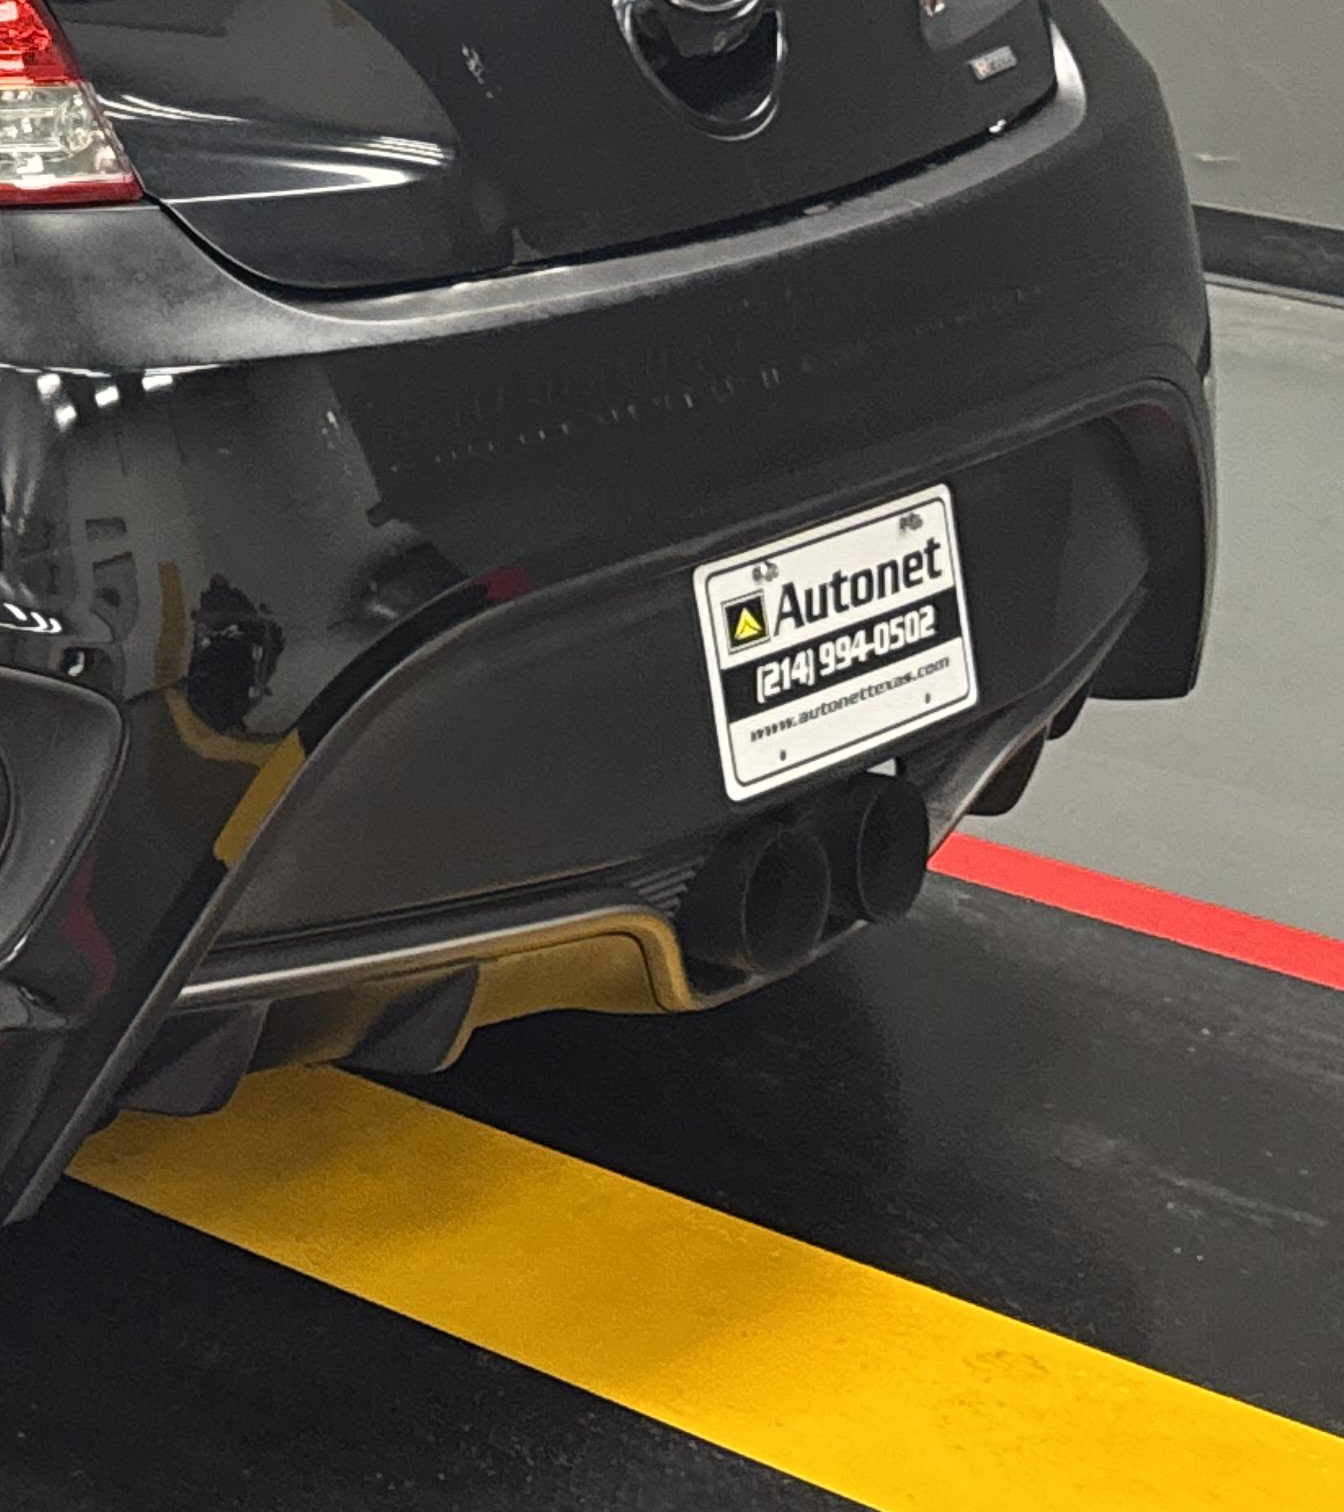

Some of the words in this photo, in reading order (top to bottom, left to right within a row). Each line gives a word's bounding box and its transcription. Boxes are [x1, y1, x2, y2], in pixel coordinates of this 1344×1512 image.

[773, 537, 942, 637] Autonet
[819, 604, 936, 677] 994-0502
[750, 655, 951, 743] www.autonettexas.com
